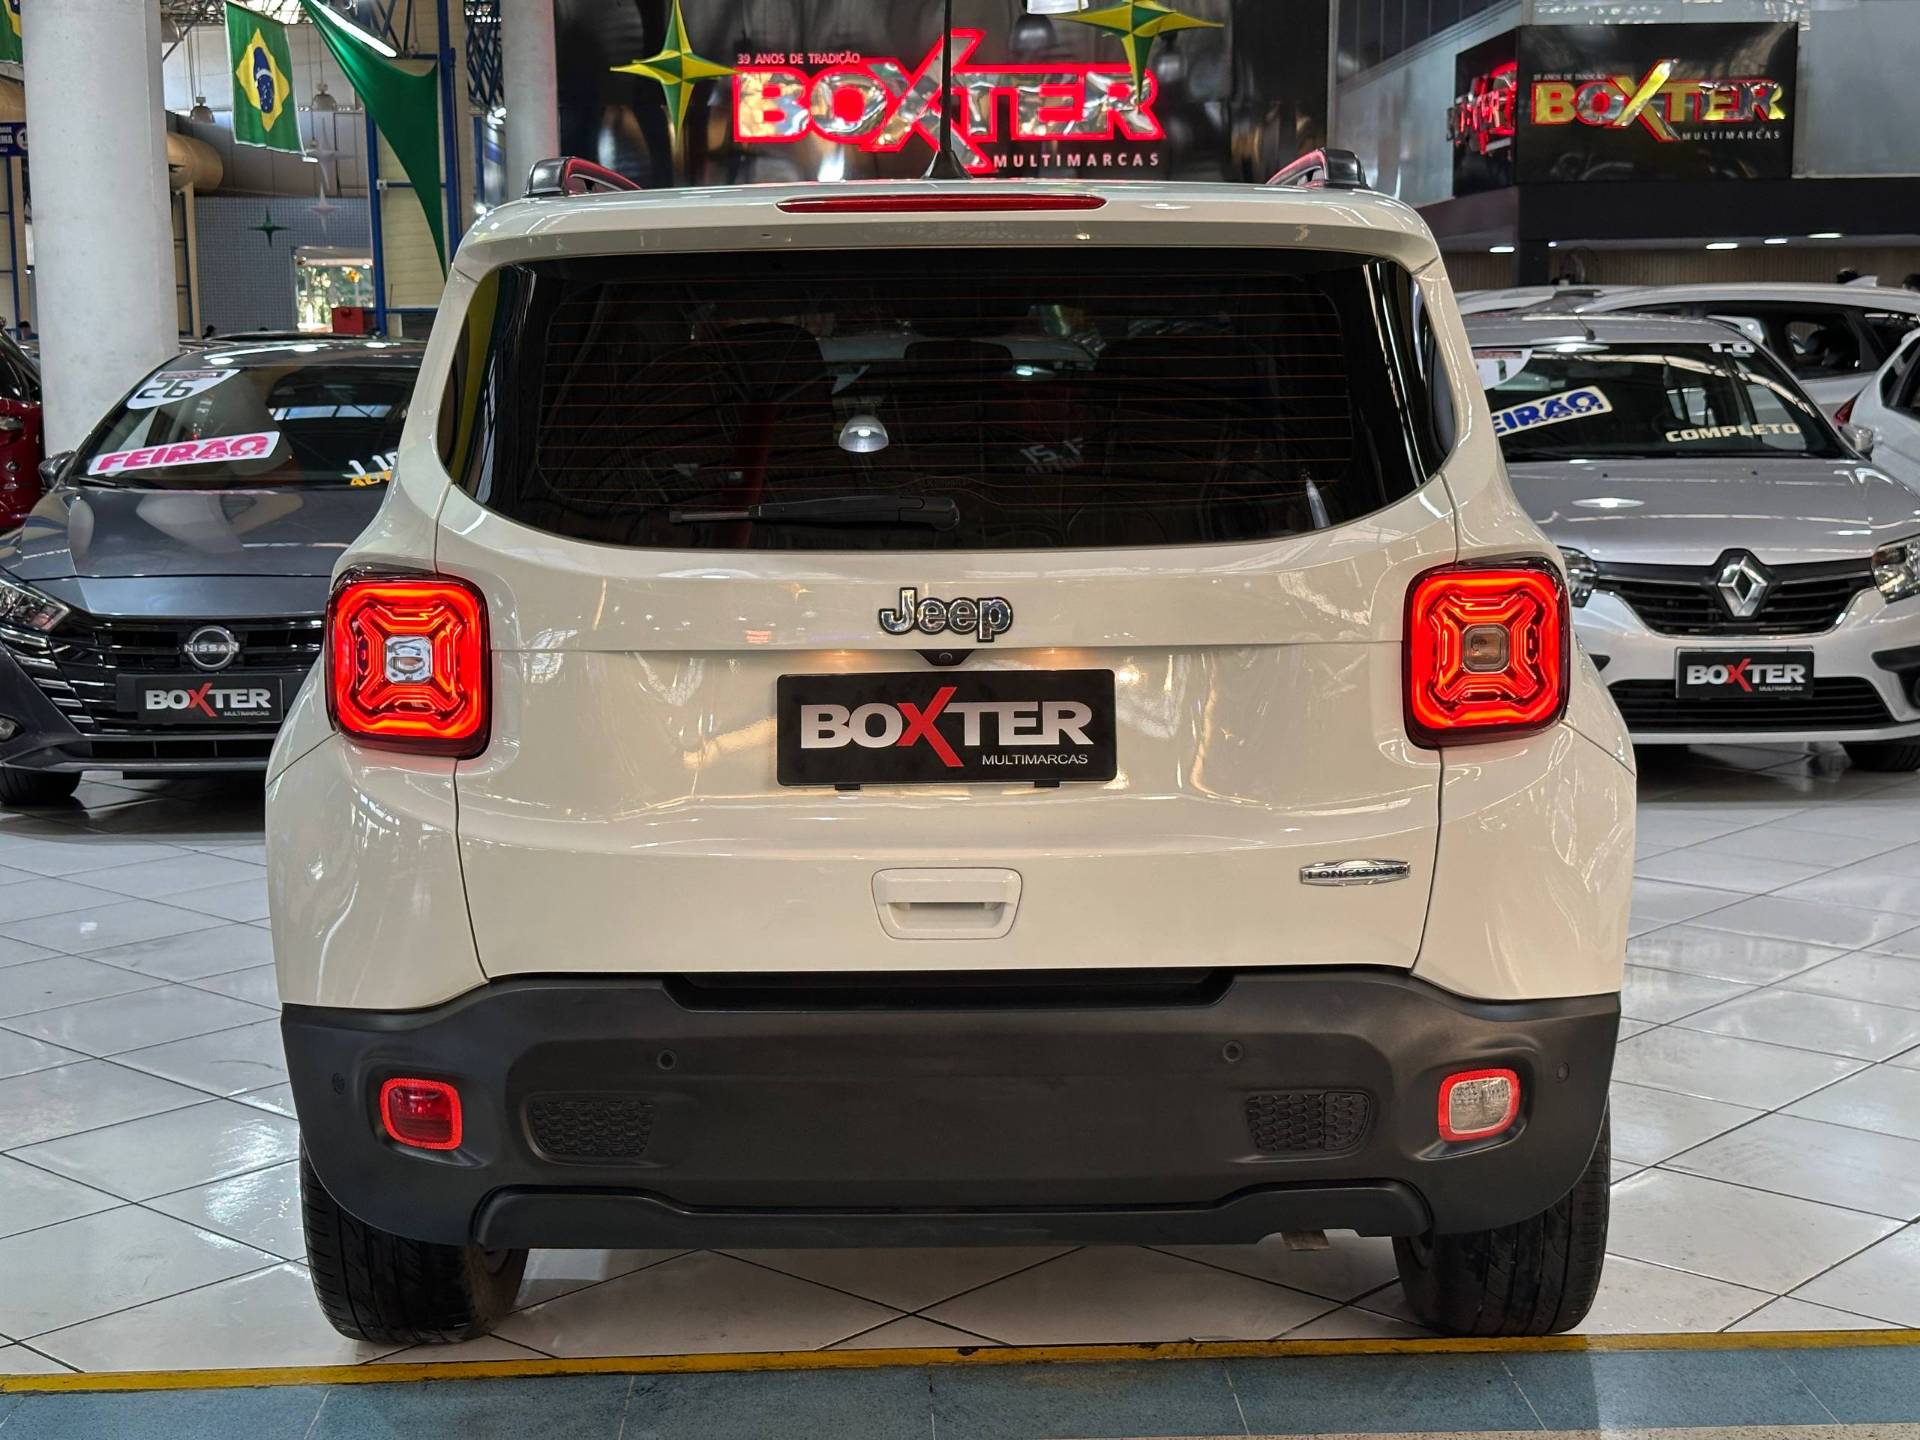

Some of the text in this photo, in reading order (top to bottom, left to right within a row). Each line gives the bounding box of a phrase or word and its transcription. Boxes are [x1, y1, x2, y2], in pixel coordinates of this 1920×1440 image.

[737, 50, 861, 65] 39 ANOS DE TRADIÇÃO
[733, 28, 1167, 174] BOXTER
[1530, 56, 1787, 143] BOXTER
[1681, 130, 1781, 141] MULTIMARCAS
[993, 152, 1160, 168] MULTIMARCAS
[1708, 343, 1756, 353] 1.0
[136, 379, 194, 399] 26
[1491, 391, 1602, 434] EIRÃO
[1665, 423, 1800, 443] COMPLETO
[878, 587, 1013, 642] Jeep
[184, 642, 240, 653] NISSAN
[1686, 658, 1806, 692] BOXTER
[145, 681, 272, 717] BOXTER
[800, 686, 1094, 768] BOXTER
[982, 754, 1089, 766] MULTIMARCAS
[1304, 865, 1407, 879] LONGITUDE
